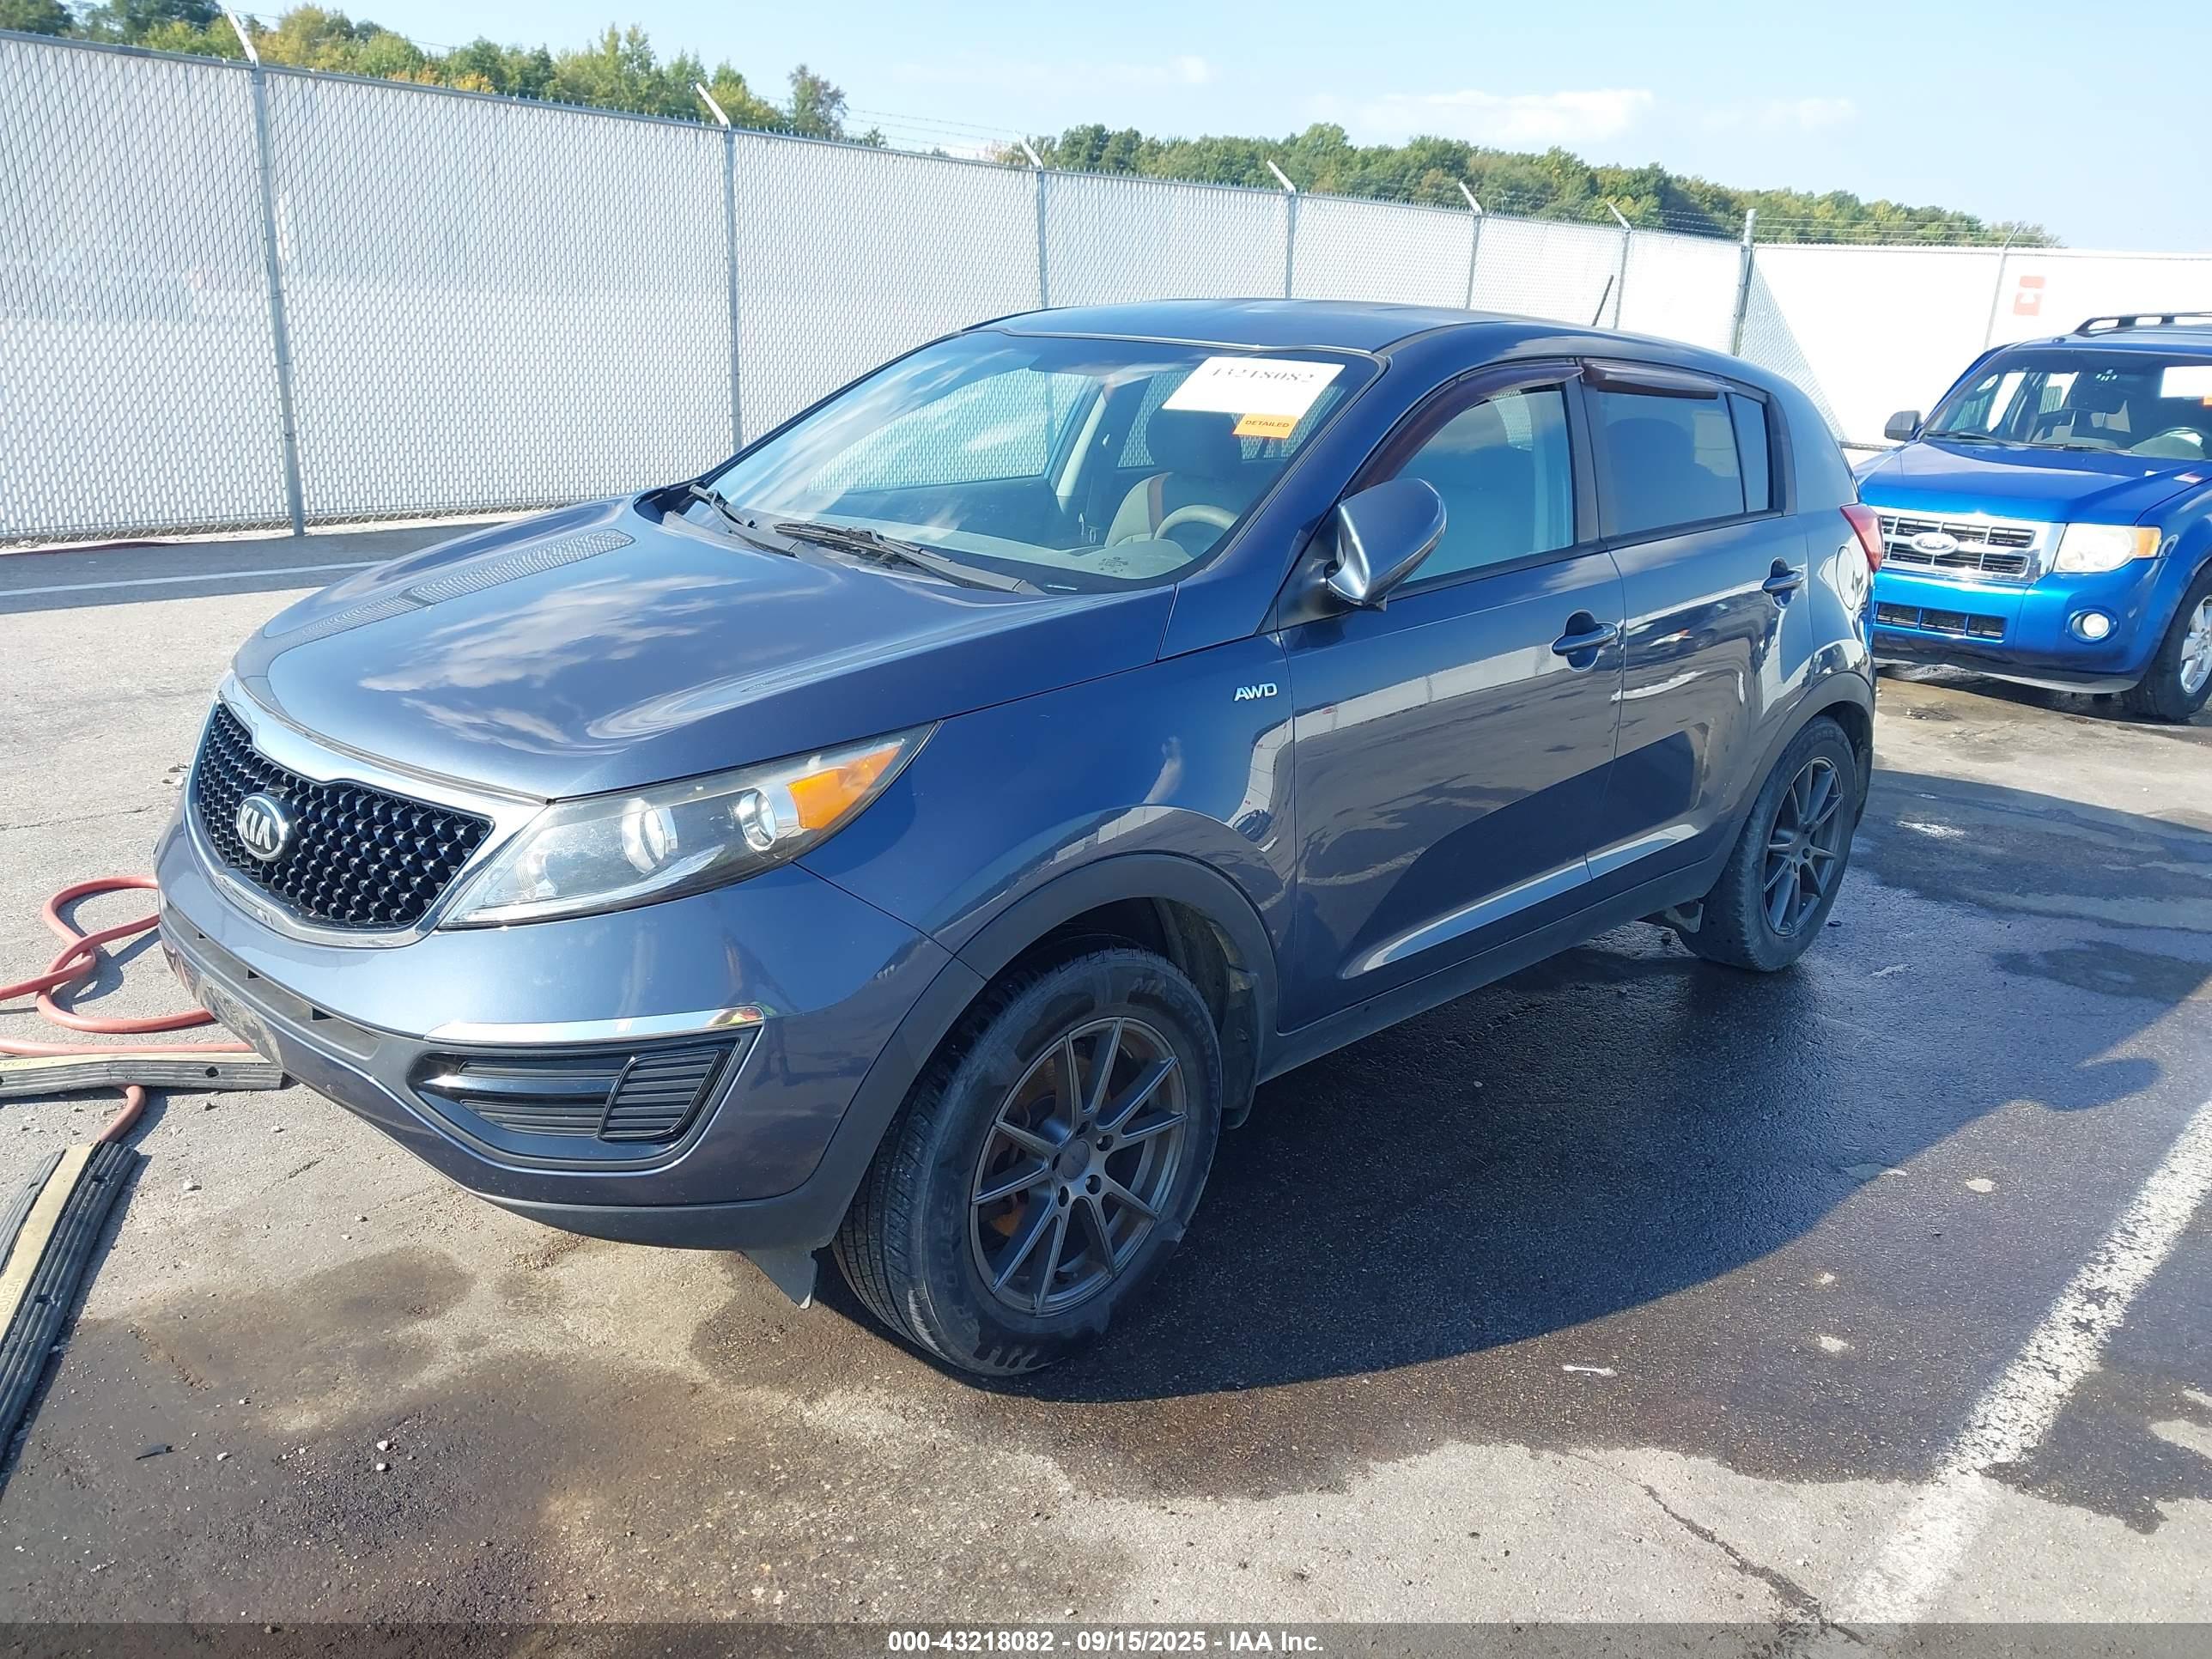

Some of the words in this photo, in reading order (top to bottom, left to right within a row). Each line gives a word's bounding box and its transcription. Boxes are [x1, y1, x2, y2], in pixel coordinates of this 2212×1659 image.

[1244, 418, 1290, 428] DETAILED
[1234, 683, 1278, 702] AWD
[237, 804, 272, 850] KIA
